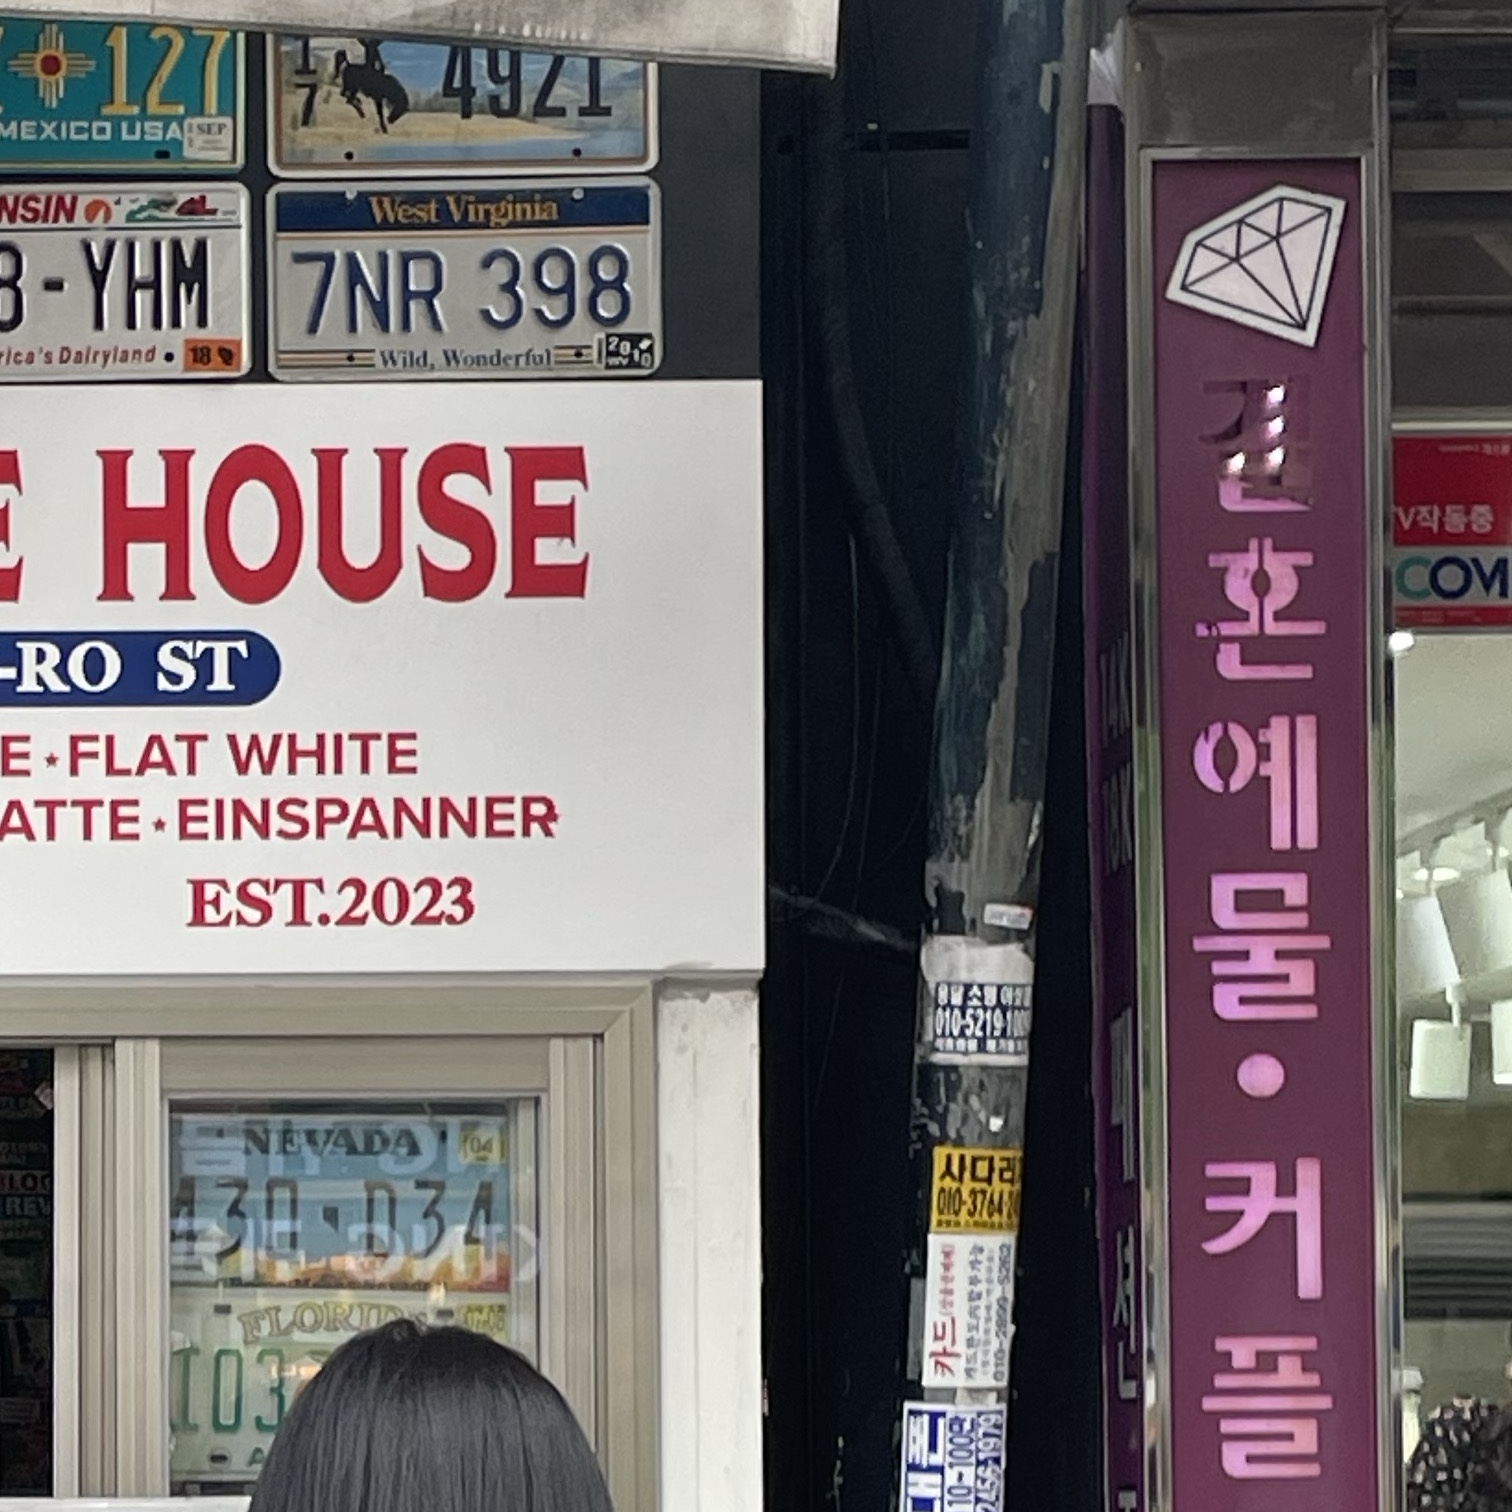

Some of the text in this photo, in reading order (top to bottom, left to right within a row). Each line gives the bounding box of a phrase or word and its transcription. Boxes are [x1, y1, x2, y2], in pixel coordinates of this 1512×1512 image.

[100, 26, 231, 117] 127
[121, 119, 184, 142] USA
[196, 121, 228, 137] SEP
[368, 195, 560, 229] West Virginia
[292, 243, 632, 336] 7NR 398
[58, 344, 157, 369] Dairyland
[378, 347, 552, 374] Wild, Wonderful
[94, 442, 590, 607] HOUSE
[156, 639, 248, 694] ST
[68, 733, 210, 779] FLAT
[227, 731, 419, 777] WHITE
[178, 795, 560, 842] EINSPANNER
[185, 876, 475, 930] EST.2023
[243, 1126, 424, 1157] NEVADA
[468, 1136, 495, 1154] 04
